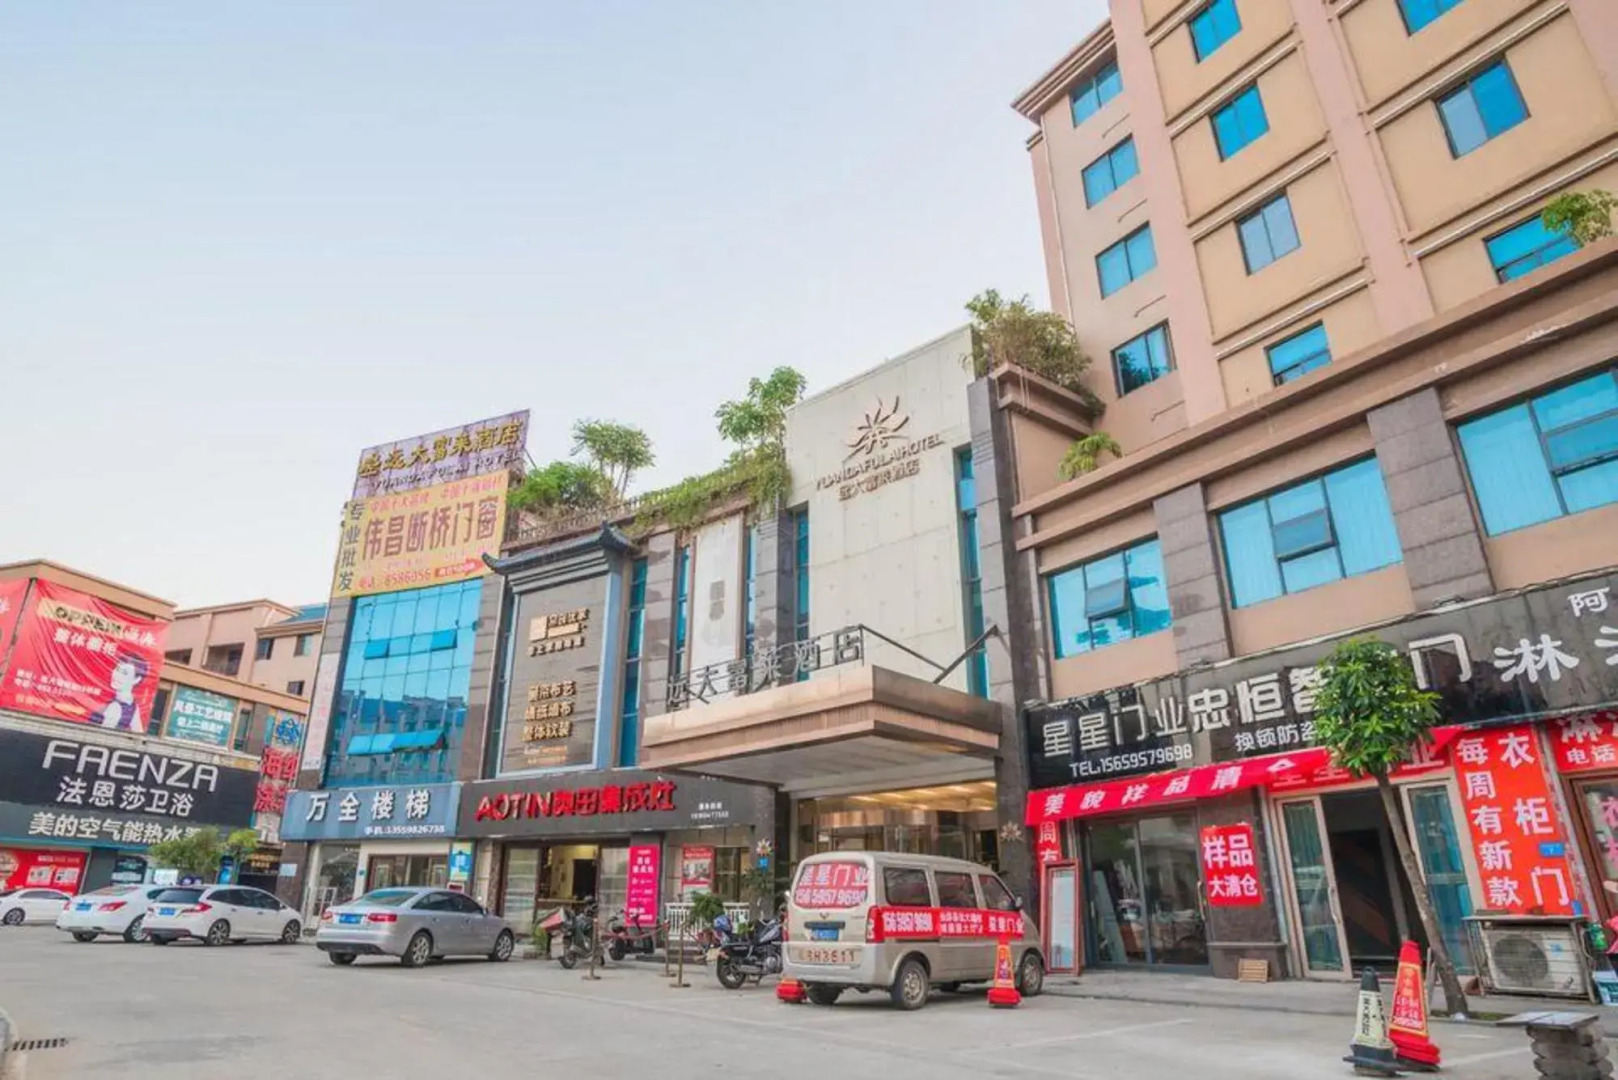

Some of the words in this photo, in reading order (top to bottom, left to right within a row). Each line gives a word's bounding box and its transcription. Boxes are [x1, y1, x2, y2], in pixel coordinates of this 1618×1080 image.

[338, 502, 365, 591] 专业批发
[361, 496, 499, 561] 伟昌断桥门窗
[1567, 587, 1610, 617] 阿
[1043, 697, 1190, 758] 星星门业
[42, 739, 219, 792] FAENZA
[1566, 743, 1616, 763] 电话
[56, 776, 194, 817] 法恩莎卫浴
[306, 789, 431, 822] 万全楼梯
[1456, 737, 1523, 907] 每周有新款
[1202, 833, 1254, 869] 样品
[799, 864, 870, 887] 星星门业
[1208, 873, 1258, 898] 大清仓
